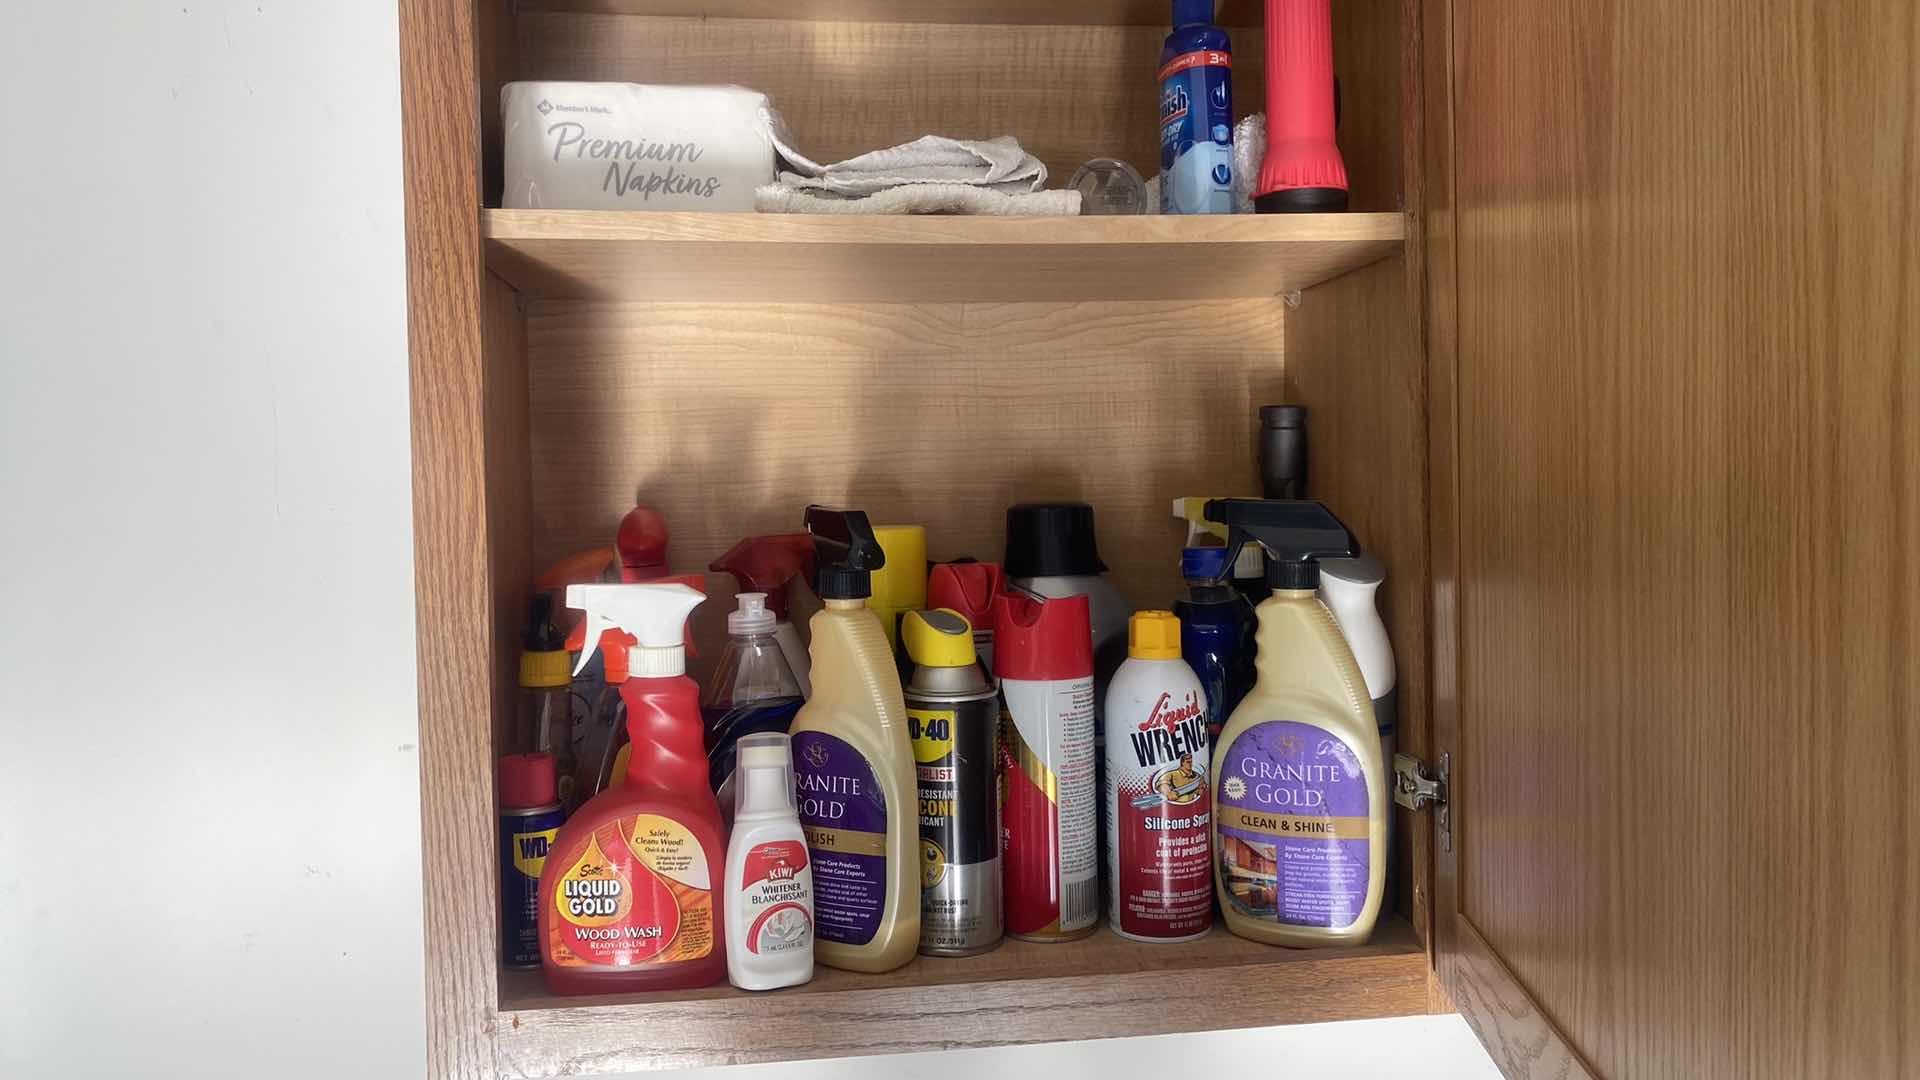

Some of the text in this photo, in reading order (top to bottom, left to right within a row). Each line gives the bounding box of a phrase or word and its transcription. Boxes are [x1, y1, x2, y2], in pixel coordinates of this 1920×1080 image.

[1160, 85, 1187, 117] nish
[547, 121, 704, 162] Premium
[603, 161, 721, 200] Napkins
[1139, 690, 1200, 734] Liquid
[907, 717, 949, 741] D-40
[1241, 757, 1340, 782] GRANITE
[797, 773, 861, 796] RANITE
[1255, 783, 1321, 807] GOLD
[799, 797, 844, 819] OLD
[1144, 816, 1191, 830] Silicone
[1240, 815, 1334, 833] CLEAN & SHINE
[635, 836, 659, 845] Cleans
[649, 829, 670, 838] Safely
[804, 831, 835, 846] OLISH
[1158, 836, 1189, 847] Provides
[1190, 837, 1195, 845] a
[519, 837, 552, 859] WD-
[1156, 848, 1173, 858] coat
[1173, 847, 1181, 857] of
[769, 867, 793, 880] KIWI
[565, 880, 622, 897] LIQUID
[762, 883, 801, 895] WHITENER
[752, 890, 808, 905] BLANCHISSANT
[569, 898, 618, 916] GOLD
[575, 926, 663, 941] WOOD WASH
[590, 941, 646, 950] READY-TO-USE
